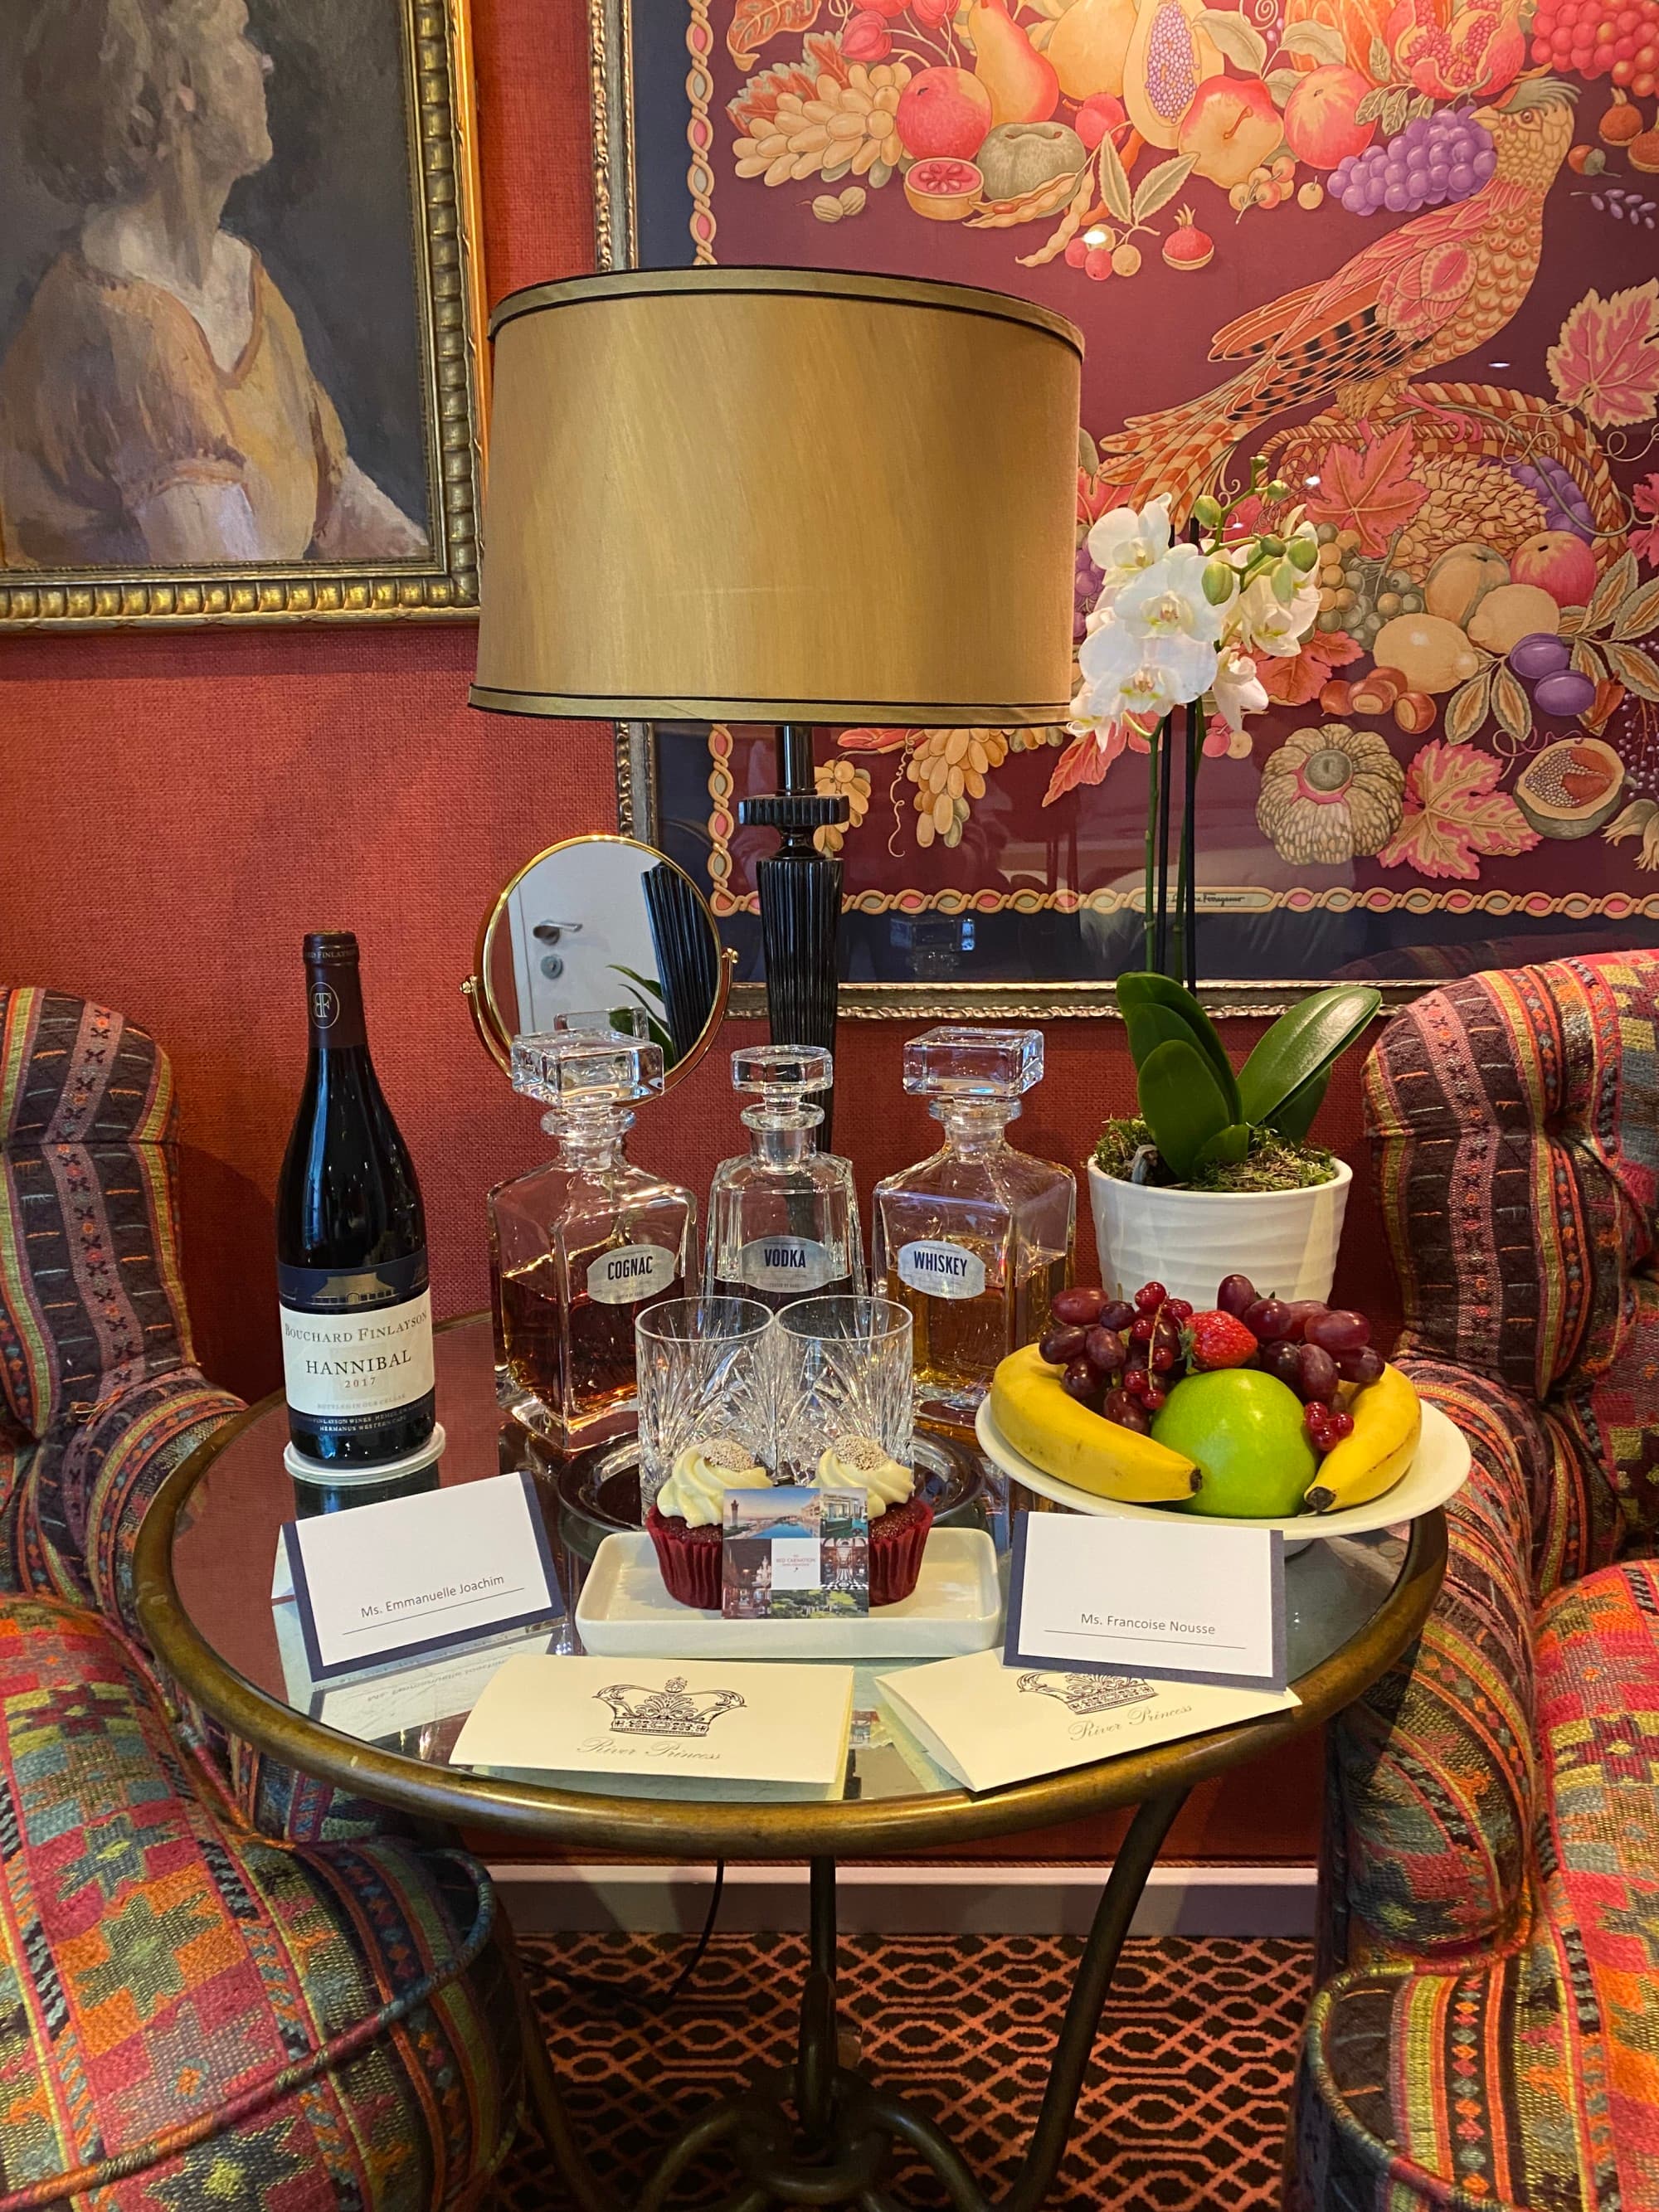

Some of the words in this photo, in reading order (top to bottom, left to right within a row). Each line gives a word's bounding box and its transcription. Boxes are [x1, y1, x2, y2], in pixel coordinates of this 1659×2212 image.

[607, 1256, 654, 1281] COGNAC
[764, 1248, 806, 1268] VODKA
[913, 1251, 968, 1277] WHISKEY
[285, 1322, 353, 1344] BOUCHARD
[358, 1310, 428, 1342] FINLAYSON
[305, 1349, 412, 1375] HANNIBAL
[344, 1376, 377, 1389] 2017
[361, 1606, 383, 1618] Ms.
[385, 1587, 457, 1612] Emmanuelle
[459, 1574, 504, 1594] Joachim
[1081, 1613, 1103, 1626] Ms.
[1107, 1615, 1166, 1631] Francoise
[1170, 1620, 1216, 1635] Nousse
[1068, 1719, 1122, 1742] River
[1126, 1704, 1193, 1726] Princess
[577, 1736, 637, 1756] River
[645, 1741, 722, 1760] Princess
